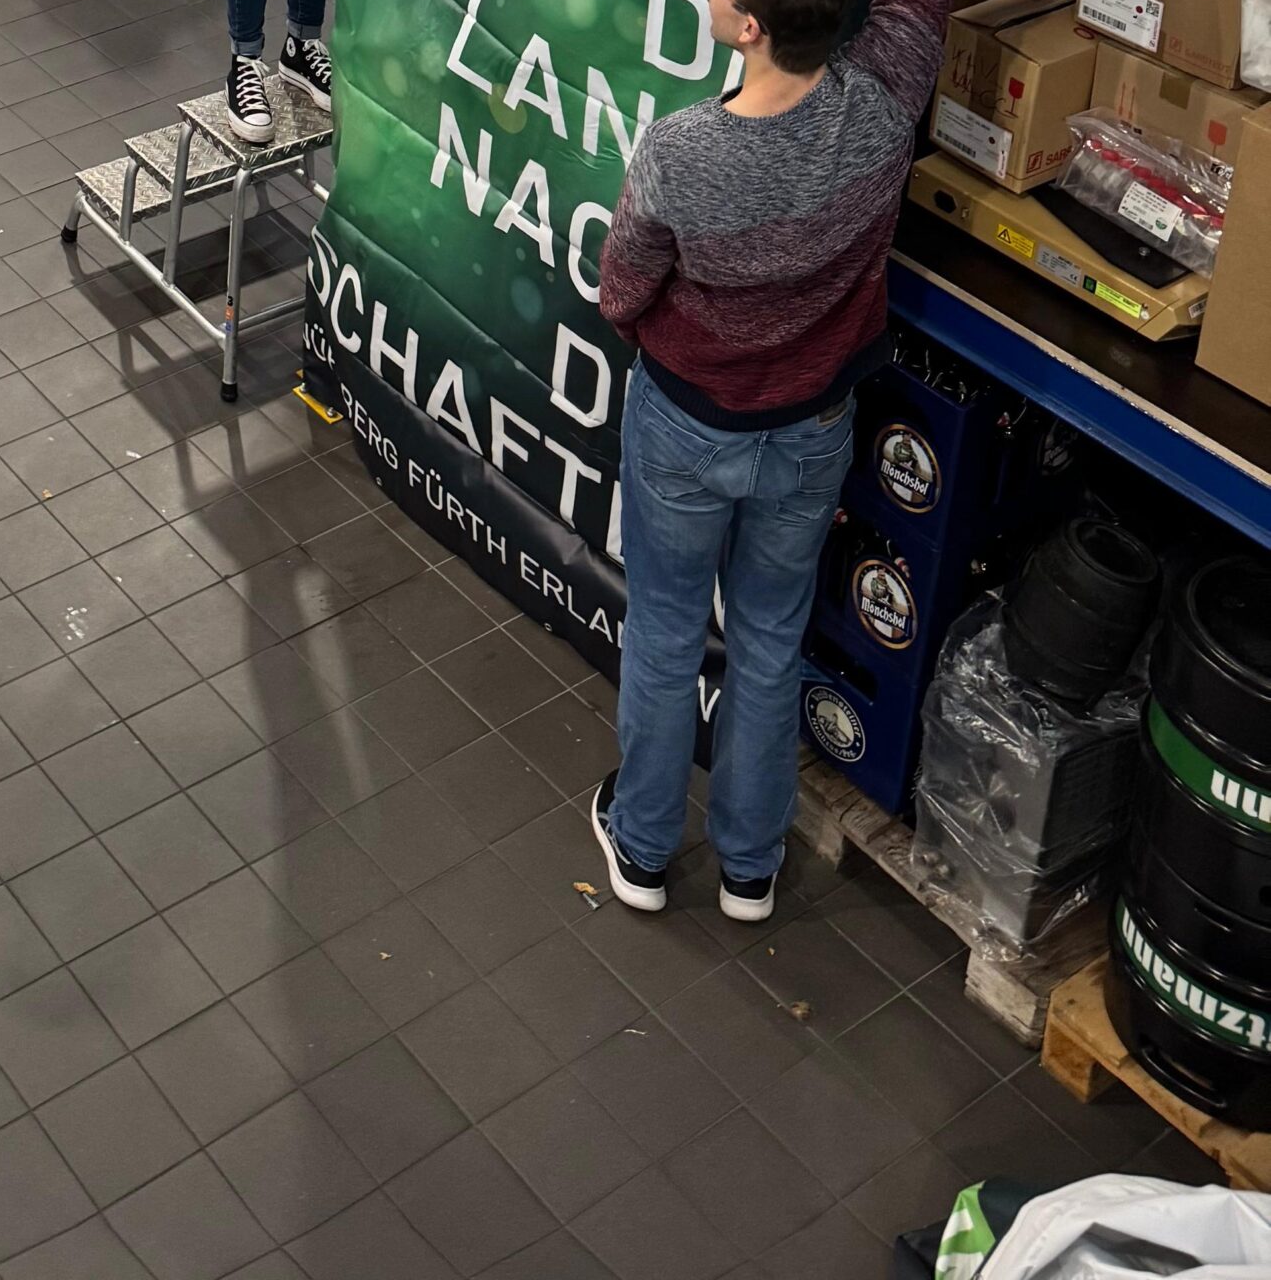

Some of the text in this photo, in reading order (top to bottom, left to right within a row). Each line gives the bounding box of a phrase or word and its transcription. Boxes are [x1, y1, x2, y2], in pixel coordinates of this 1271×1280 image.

[549, 322, 633, 428] D
[408, 458, 507, 565] FÜRTH
[519, 550, 624, 650] ERLA
